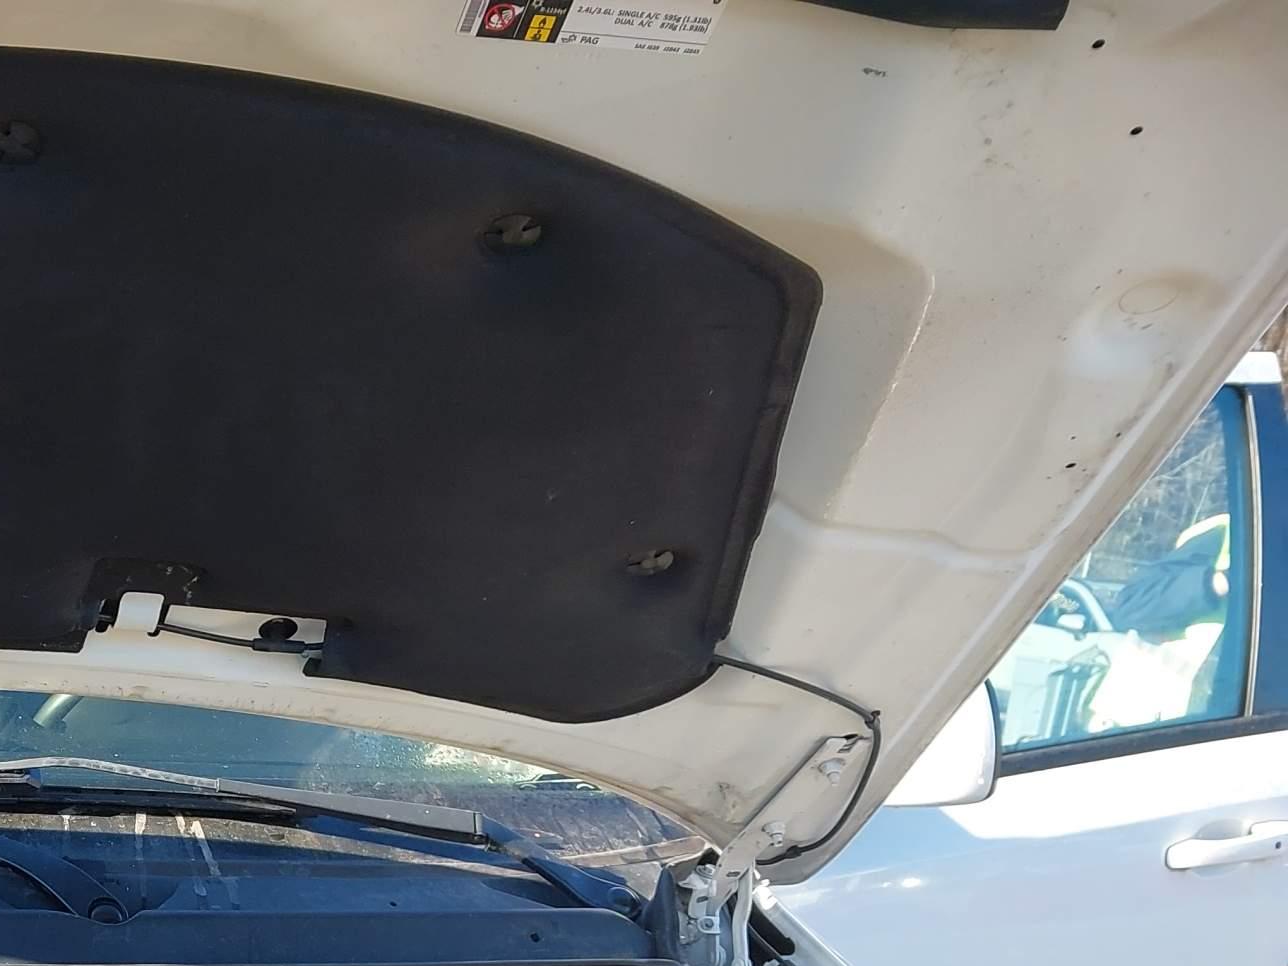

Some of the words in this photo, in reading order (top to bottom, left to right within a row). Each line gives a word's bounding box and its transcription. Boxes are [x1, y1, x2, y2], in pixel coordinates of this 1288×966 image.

[577, 5, 614, 16] 2.4L/3.6L:
[617, 9, 644, 18] SINGLE
[646, 12, 661, 20] A/C
[614, 17, 634, 26] DUAL
[637, 20, 653, 28] A/C
[580, 36, 600, 45] PAG
